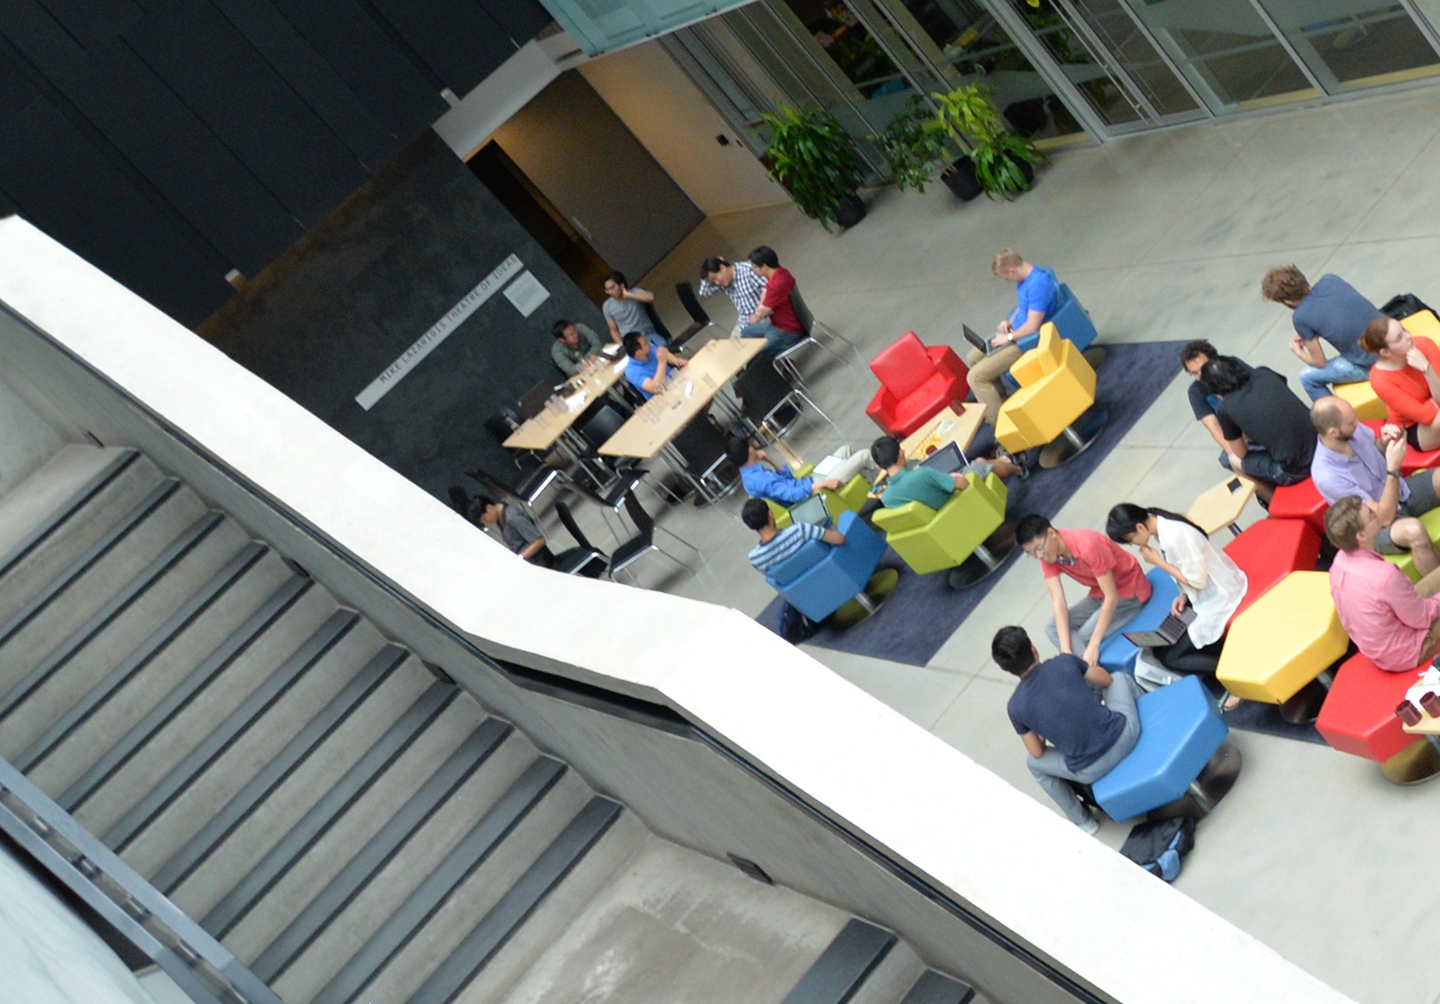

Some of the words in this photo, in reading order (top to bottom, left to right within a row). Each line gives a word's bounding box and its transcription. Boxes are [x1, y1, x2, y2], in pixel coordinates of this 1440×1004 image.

[379, 364, 401, 383] MIKE
[402, 321, 447, 363] LAZARIDIS
[447, 291, 482, 322] THEATRE
[480, 280, 492, 291] OF
[493, 256, 518, 280] IDEAS
